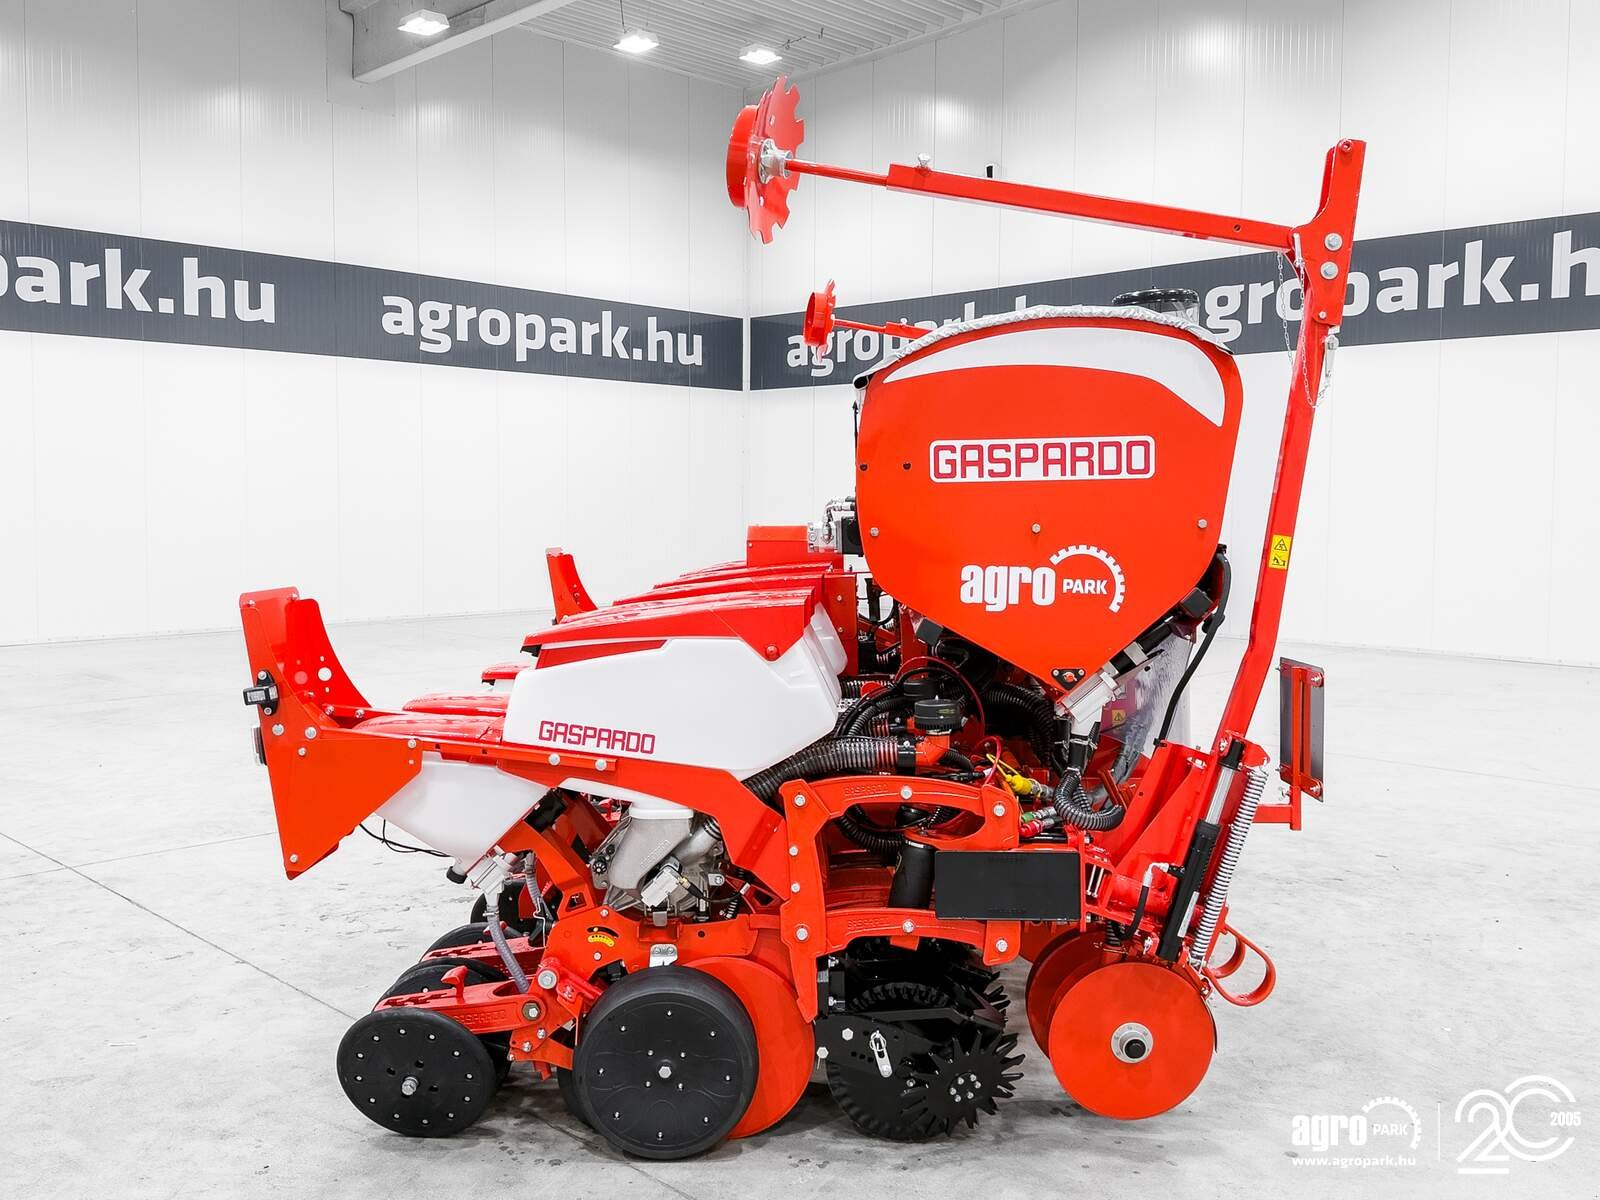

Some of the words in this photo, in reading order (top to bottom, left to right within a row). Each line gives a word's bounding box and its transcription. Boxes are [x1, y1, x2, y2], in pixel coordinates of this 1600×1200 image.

[0, 248, 275, 323] ark.hu
[381, 295, 703, 366] agropark.hu
[933, 440, 1150, 479] GASPARDO
[960, 564, 1056, 612] agro
[1062, 578, 1108, 595] PARK
[538, 720, 656, 755] GASPARDO
